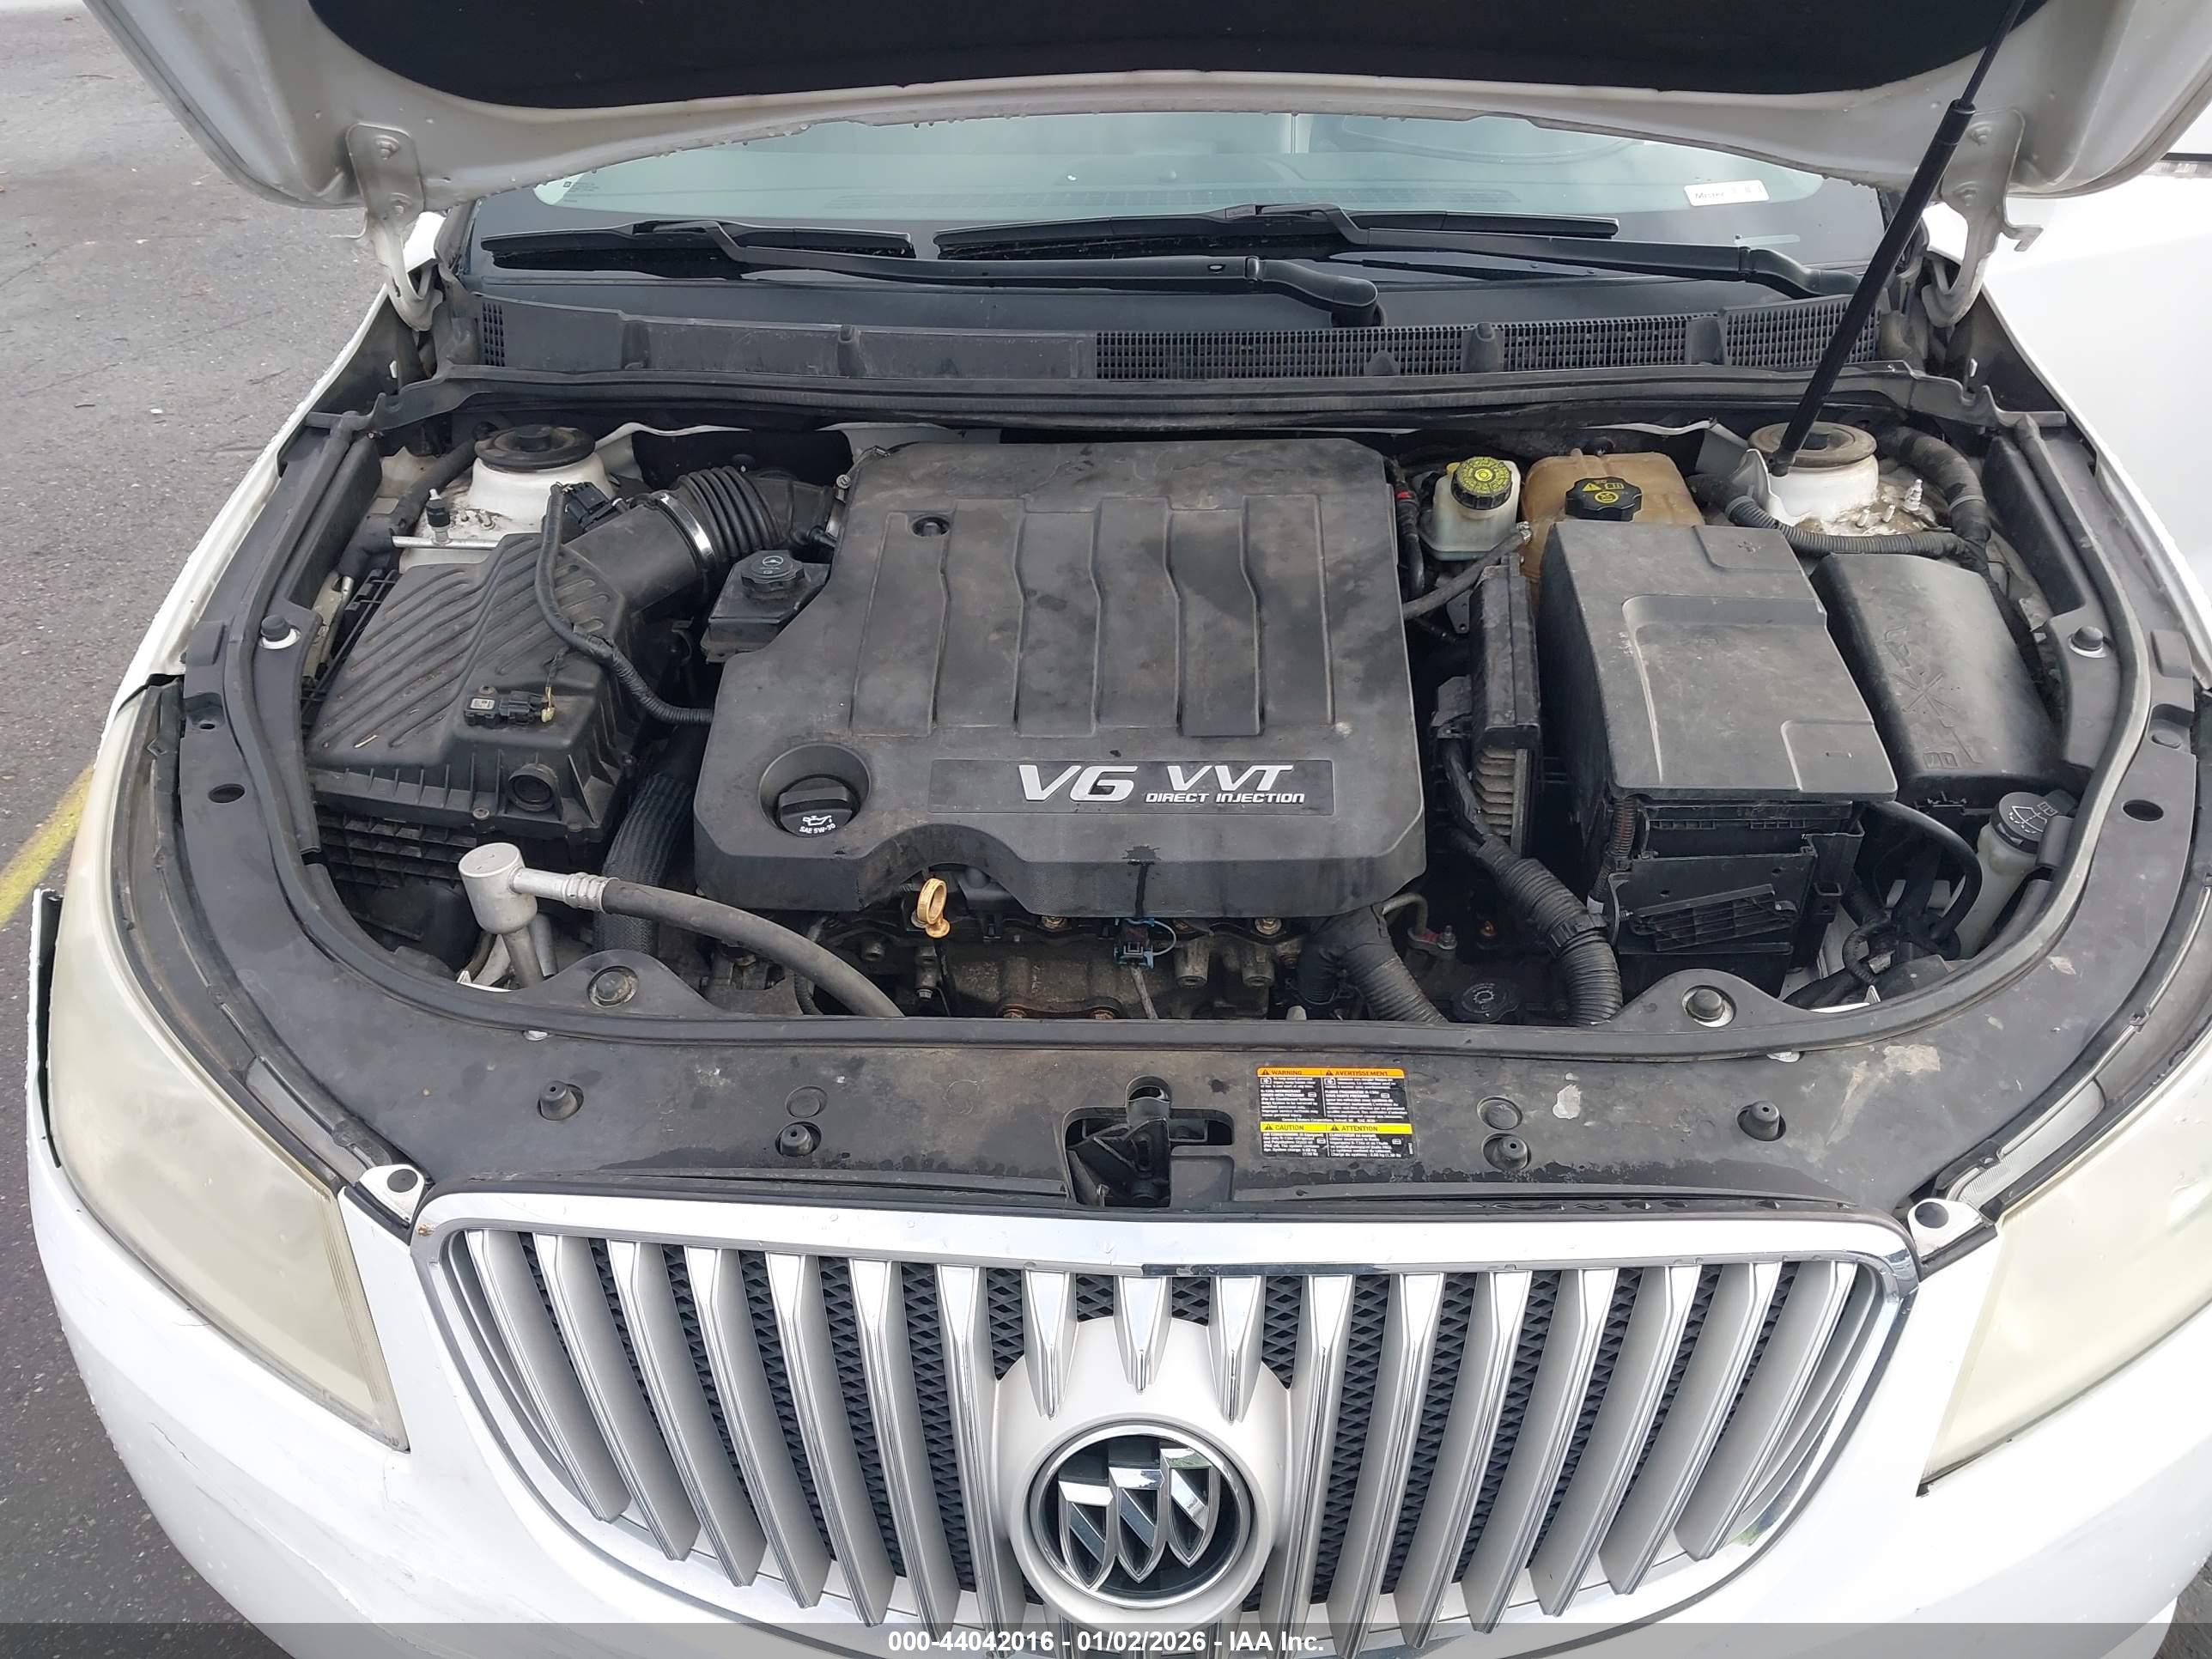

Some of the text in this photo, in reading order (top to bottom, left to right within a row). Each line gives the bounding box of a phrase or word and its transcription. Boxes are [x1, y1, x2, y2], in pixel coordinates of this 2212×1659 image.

[1018, 764, 1294, 802] V6 VVT
[1145, 793, 1305, 804] DIRECT INJECTION
[813, 823, 836, 834] 5W-30
